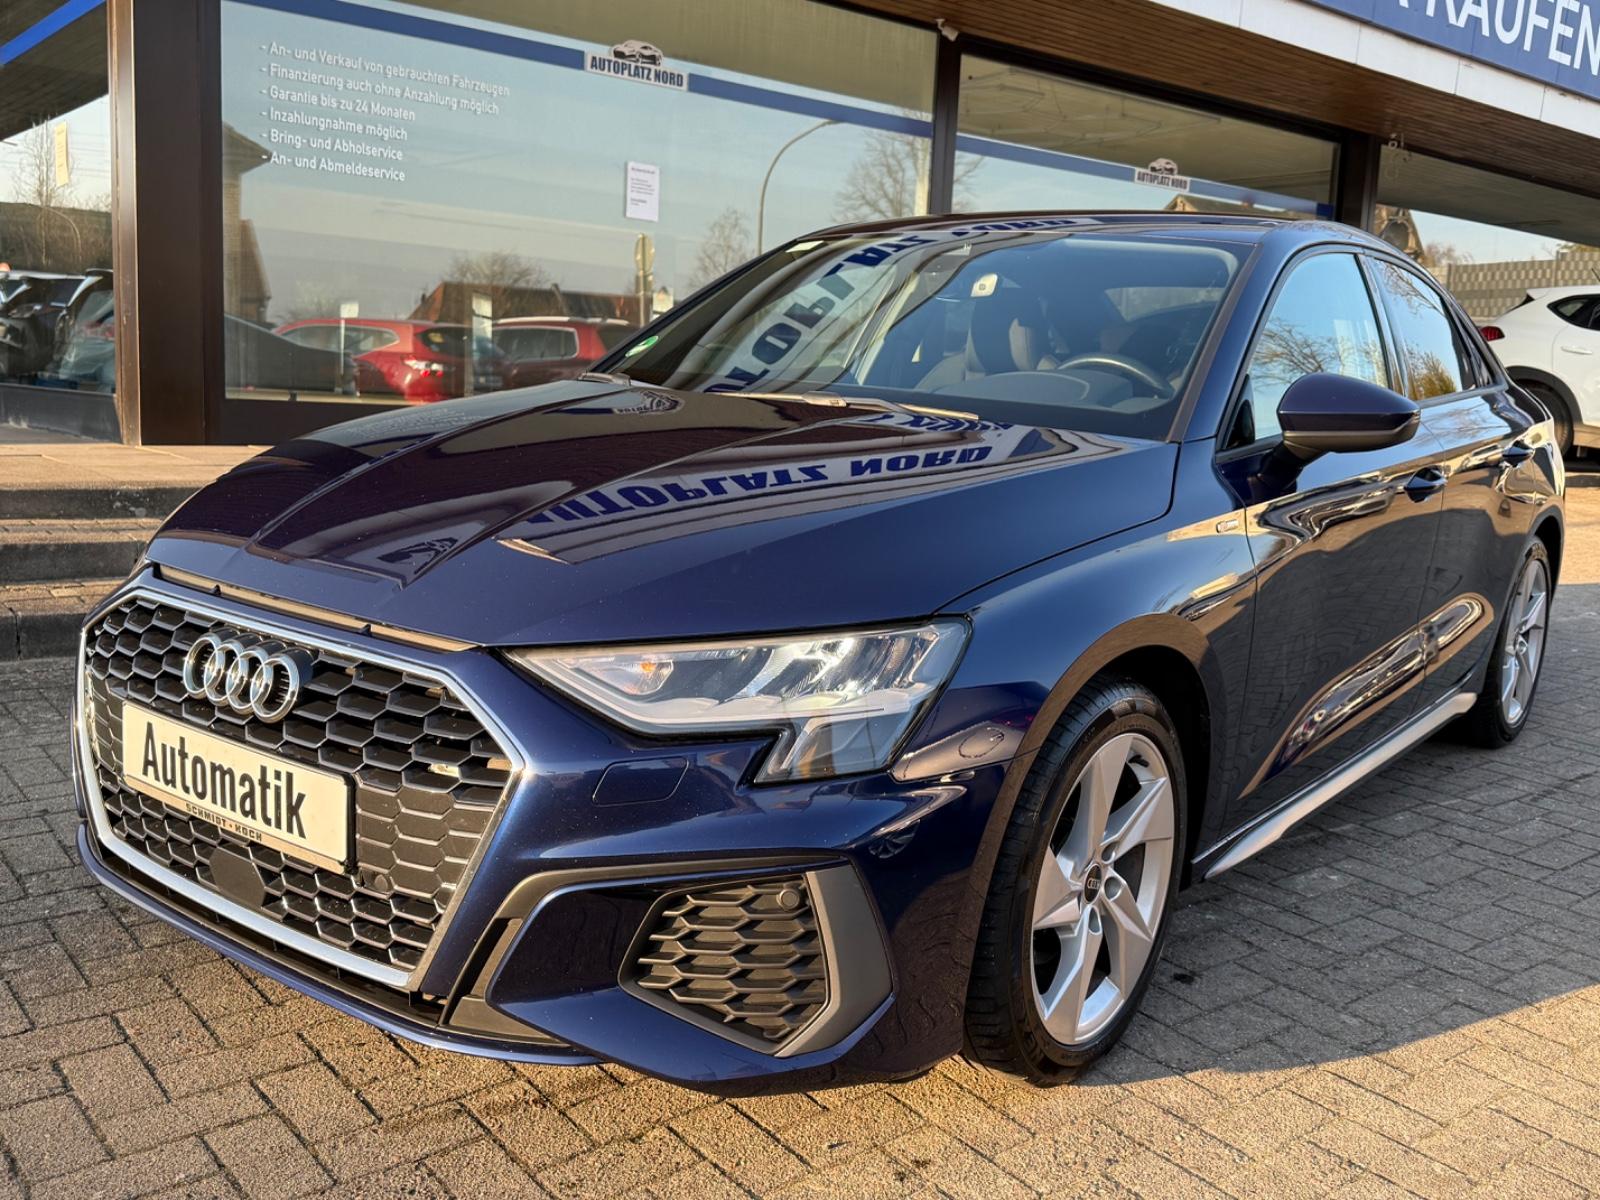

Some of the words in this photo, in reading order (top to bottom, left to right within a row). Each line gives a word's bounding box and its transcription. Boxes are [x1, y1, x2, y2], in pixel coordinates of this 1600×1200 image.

[270, 41, 291, 55] An-
[295, 48, 316, 61] und
[319, 50, 362, 69] Verkauf
[364, 60, 383, 73] von
[386, 65, 450, 87] gebrauchten
[452, 74, 510, 97] Fahrzeugen
[590, 56, 652, 81] AUTOPLATZ
[654, 69, 684, 87] NORD
[270, 63, 344, 90] Finanzierung
[346, 80, 372, 93] auch
[374, 82, 401, 98] ohne
[403, 86, 457, 110] Anzahlung
[460, 98, 499, 114] möglich
[270, 85, 318, 105] Garantie
[320, 92, 337, 108] bis
[339, 99, 353, 111] zu
[355, 99, 369, 113] 24
[371, 102, 415, 121] Monaten
[270, 107, 363, 134] Inzahlungnahme
[365, 124, 408, 141] möglich
[270, 128, 307, 149] Bring-
[310, 136, 331, 150] und
[333, 138, 403, 160] Abholservice
[270, 151, 292, 165] An-
[295, 155, 317, 169] und
[319, 156, 405, 181] Abmeldeservice
[142, 721, 307, 840] Automatik
[185, 803, 226, 828] SCHMIDT
[235, 823, 263, 842] KOCH
